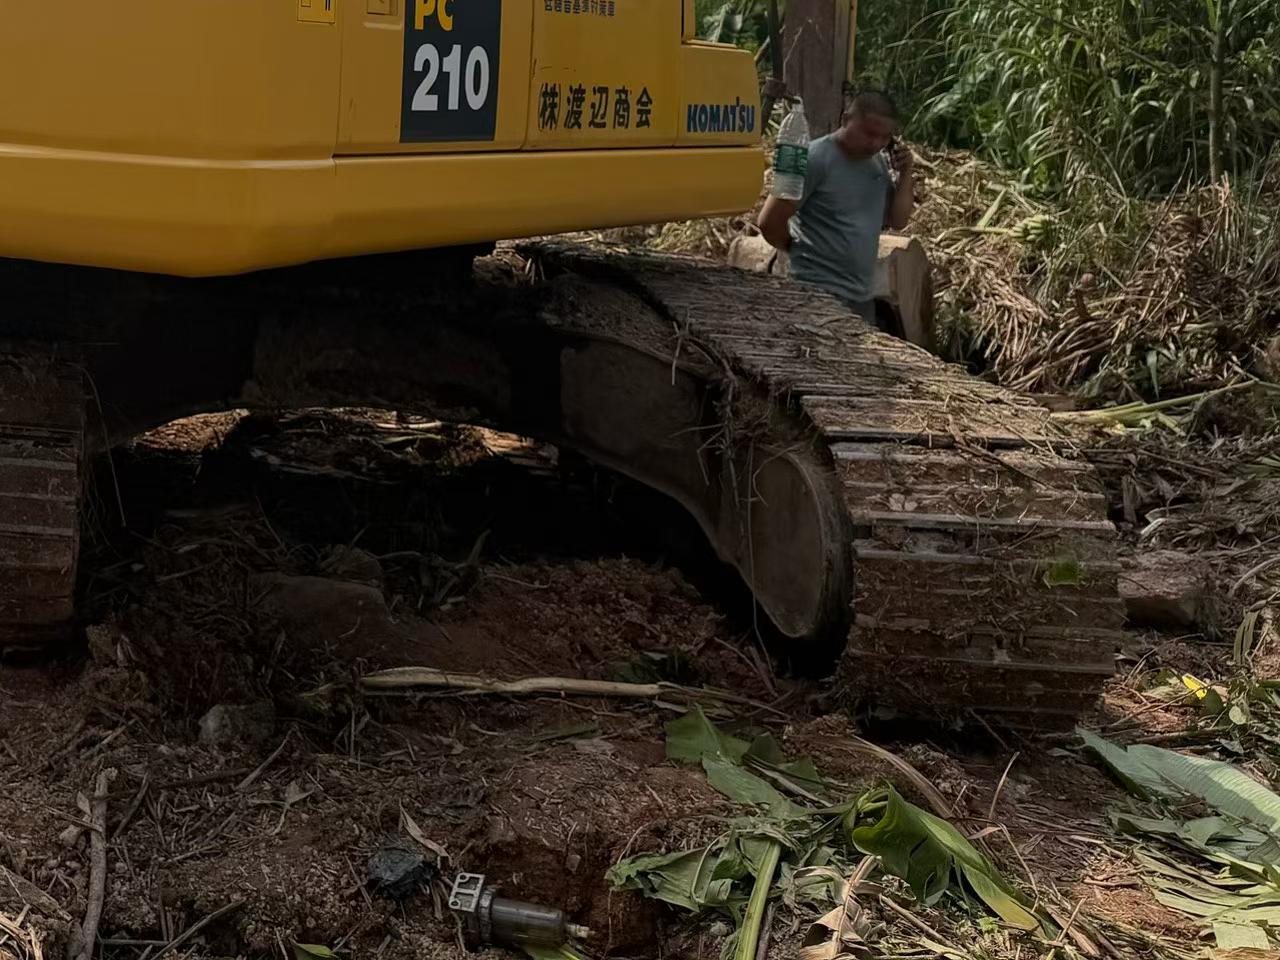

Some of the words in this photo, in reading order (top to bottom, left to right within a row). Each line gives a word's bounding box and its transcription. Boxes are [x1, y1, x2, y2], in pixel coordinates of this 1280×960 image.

[411, 43, 490, 111] 210
[537, 83, 653, 132] (株)渡辺商会
[686, 96, 755, 133] KOMATSU
